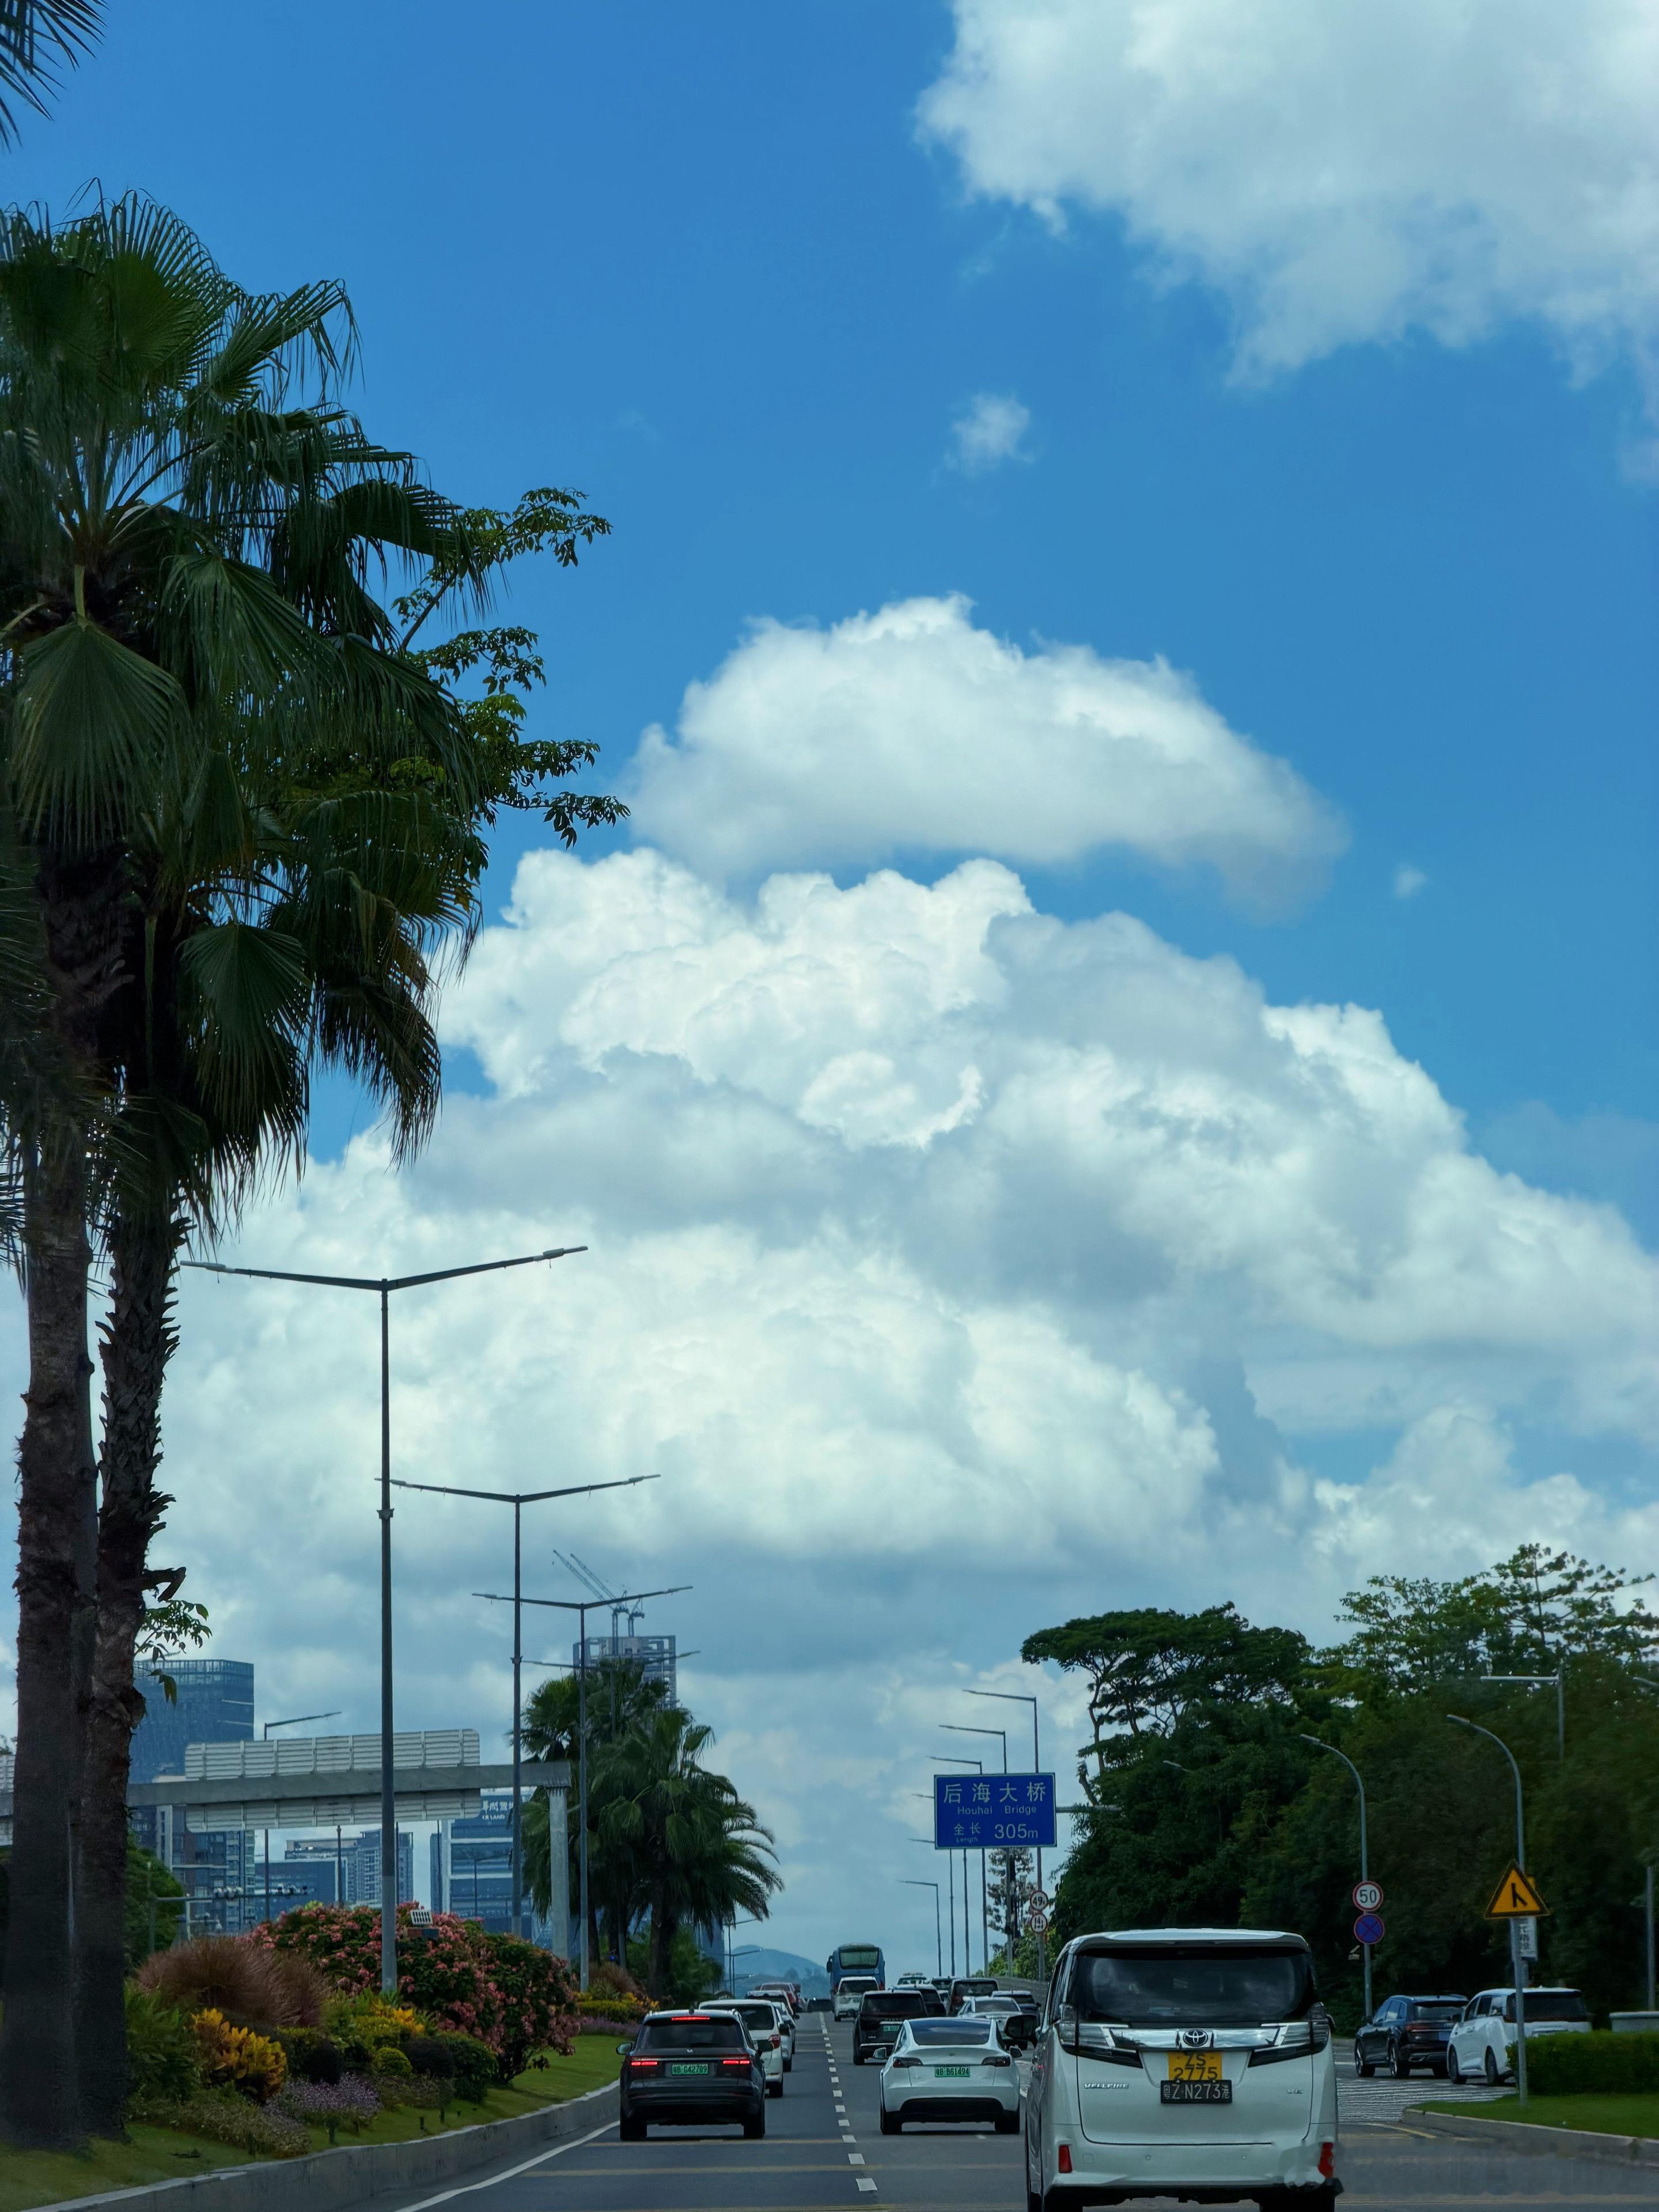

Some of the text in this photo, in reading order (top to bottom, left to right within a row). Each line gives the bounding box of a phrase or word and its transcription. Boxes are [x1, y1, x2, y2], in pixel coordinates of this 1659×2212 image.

[944, 1782, 1046, 1804] 后海大桥
[957, 1805, 1037, 1815] Houhai Bridge
[954, 1822, 1038, 1839] 全长 305m
[1359, 1889, 1377, 1903] 50
[1185, 2054, 1206, 2067] ZS
[1174, 2067, 1218, 2080] 2775
